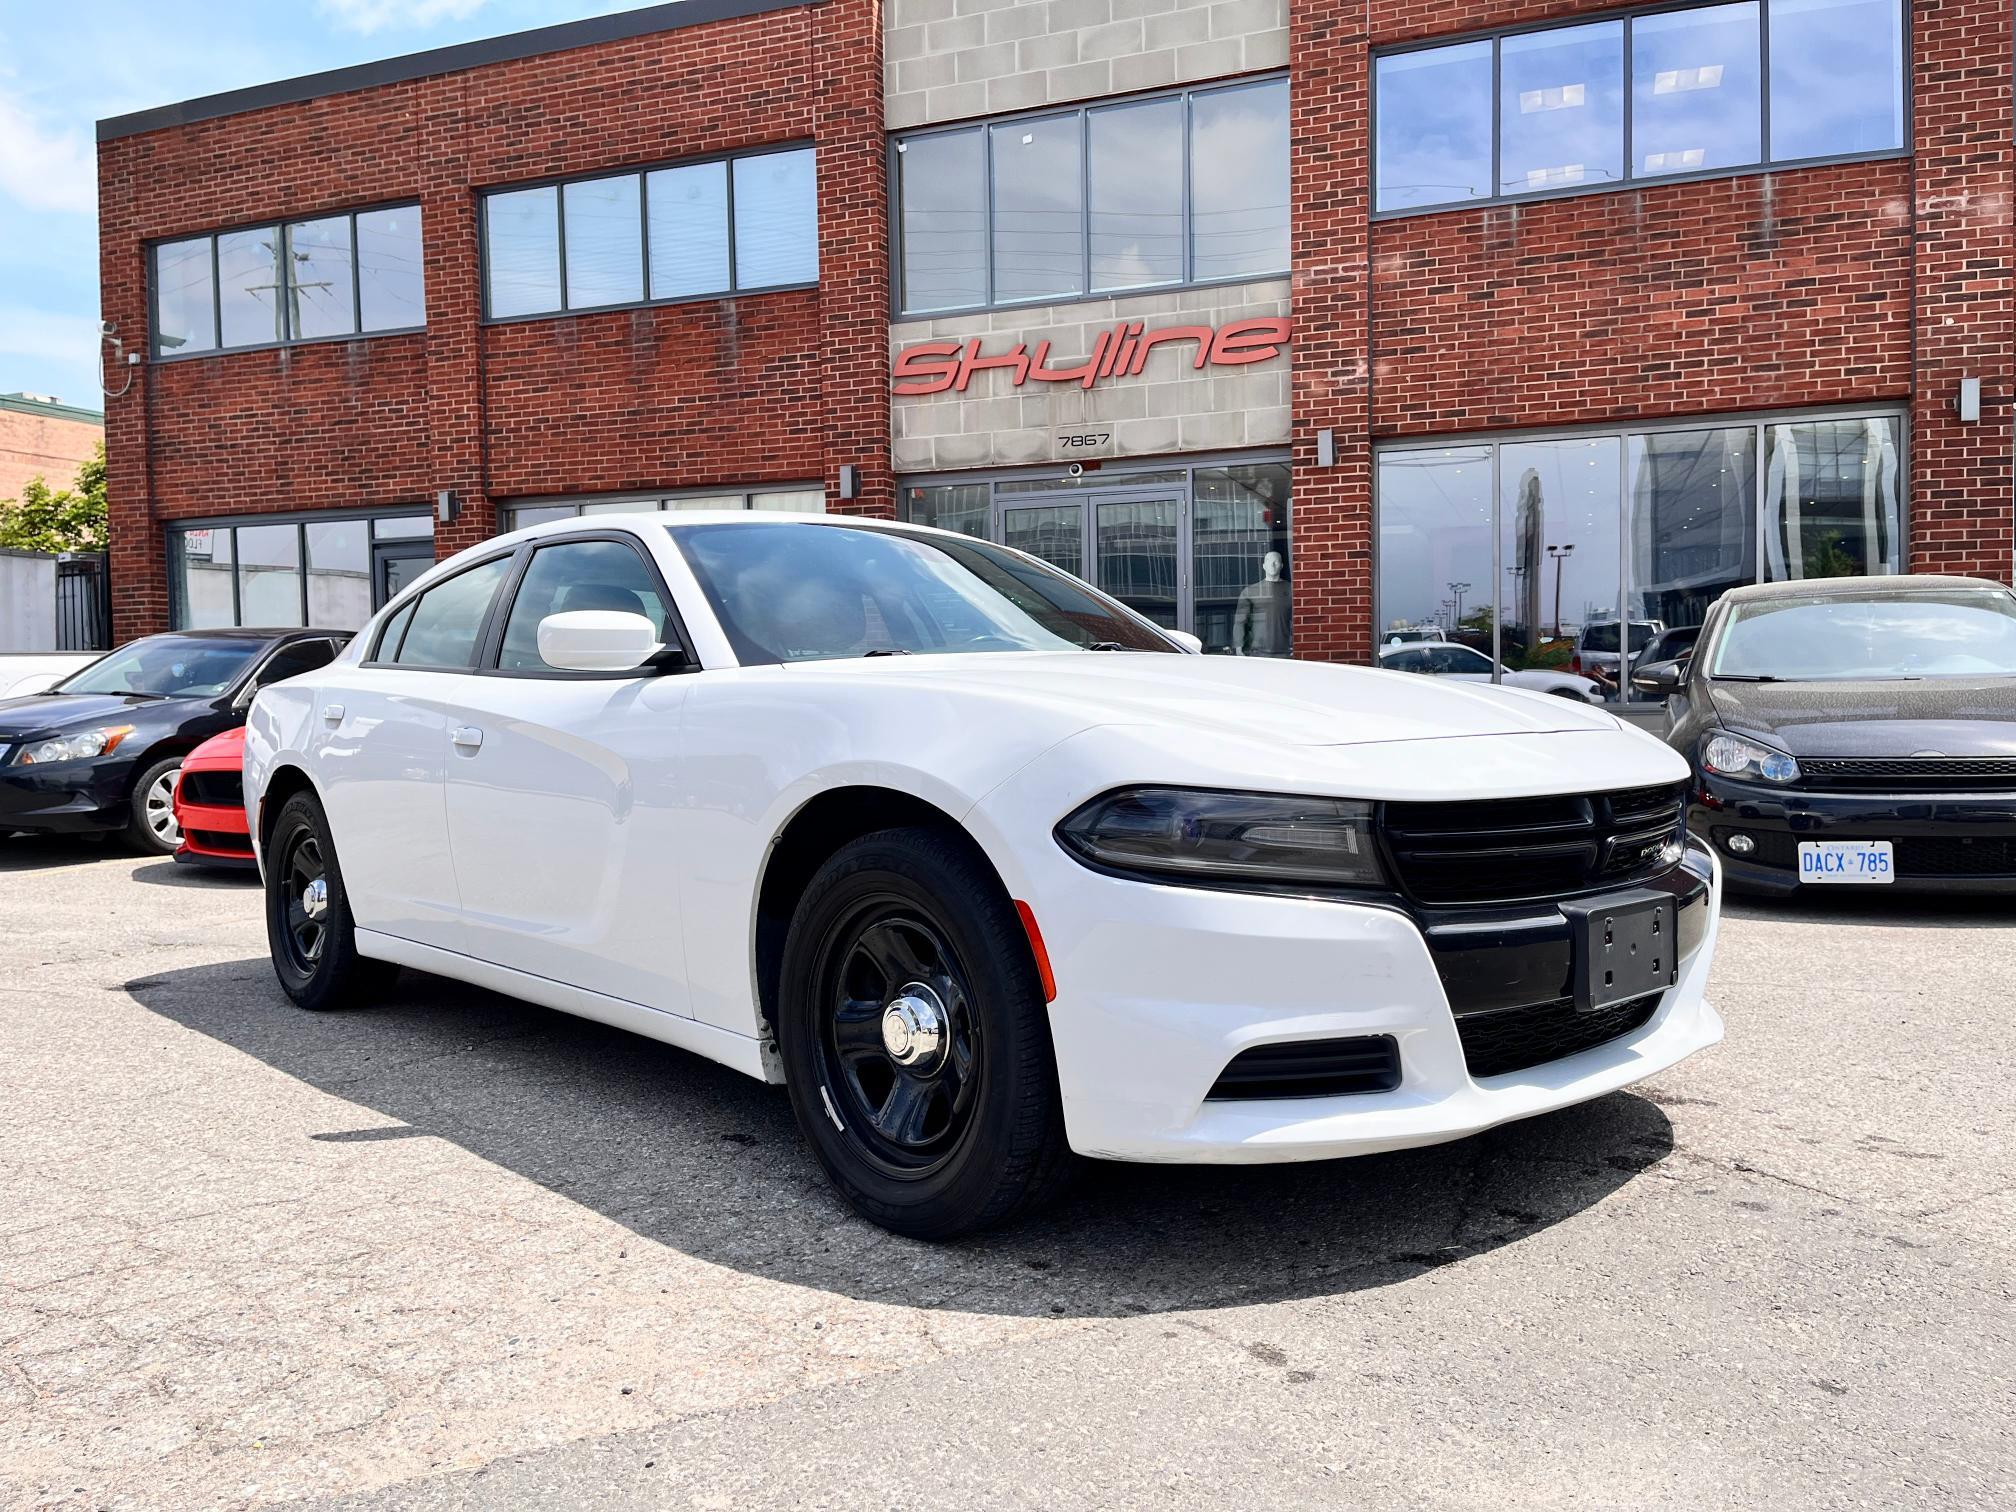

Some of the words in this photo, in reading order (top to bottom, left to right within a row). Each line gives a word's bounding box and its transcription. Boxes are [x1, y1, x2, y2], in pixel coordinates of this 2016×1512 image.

[1058, 433, 1110, 447] 7867
[1803, 852, 1845, 872] DACX
[1857, 852, 1889, 872] 785
